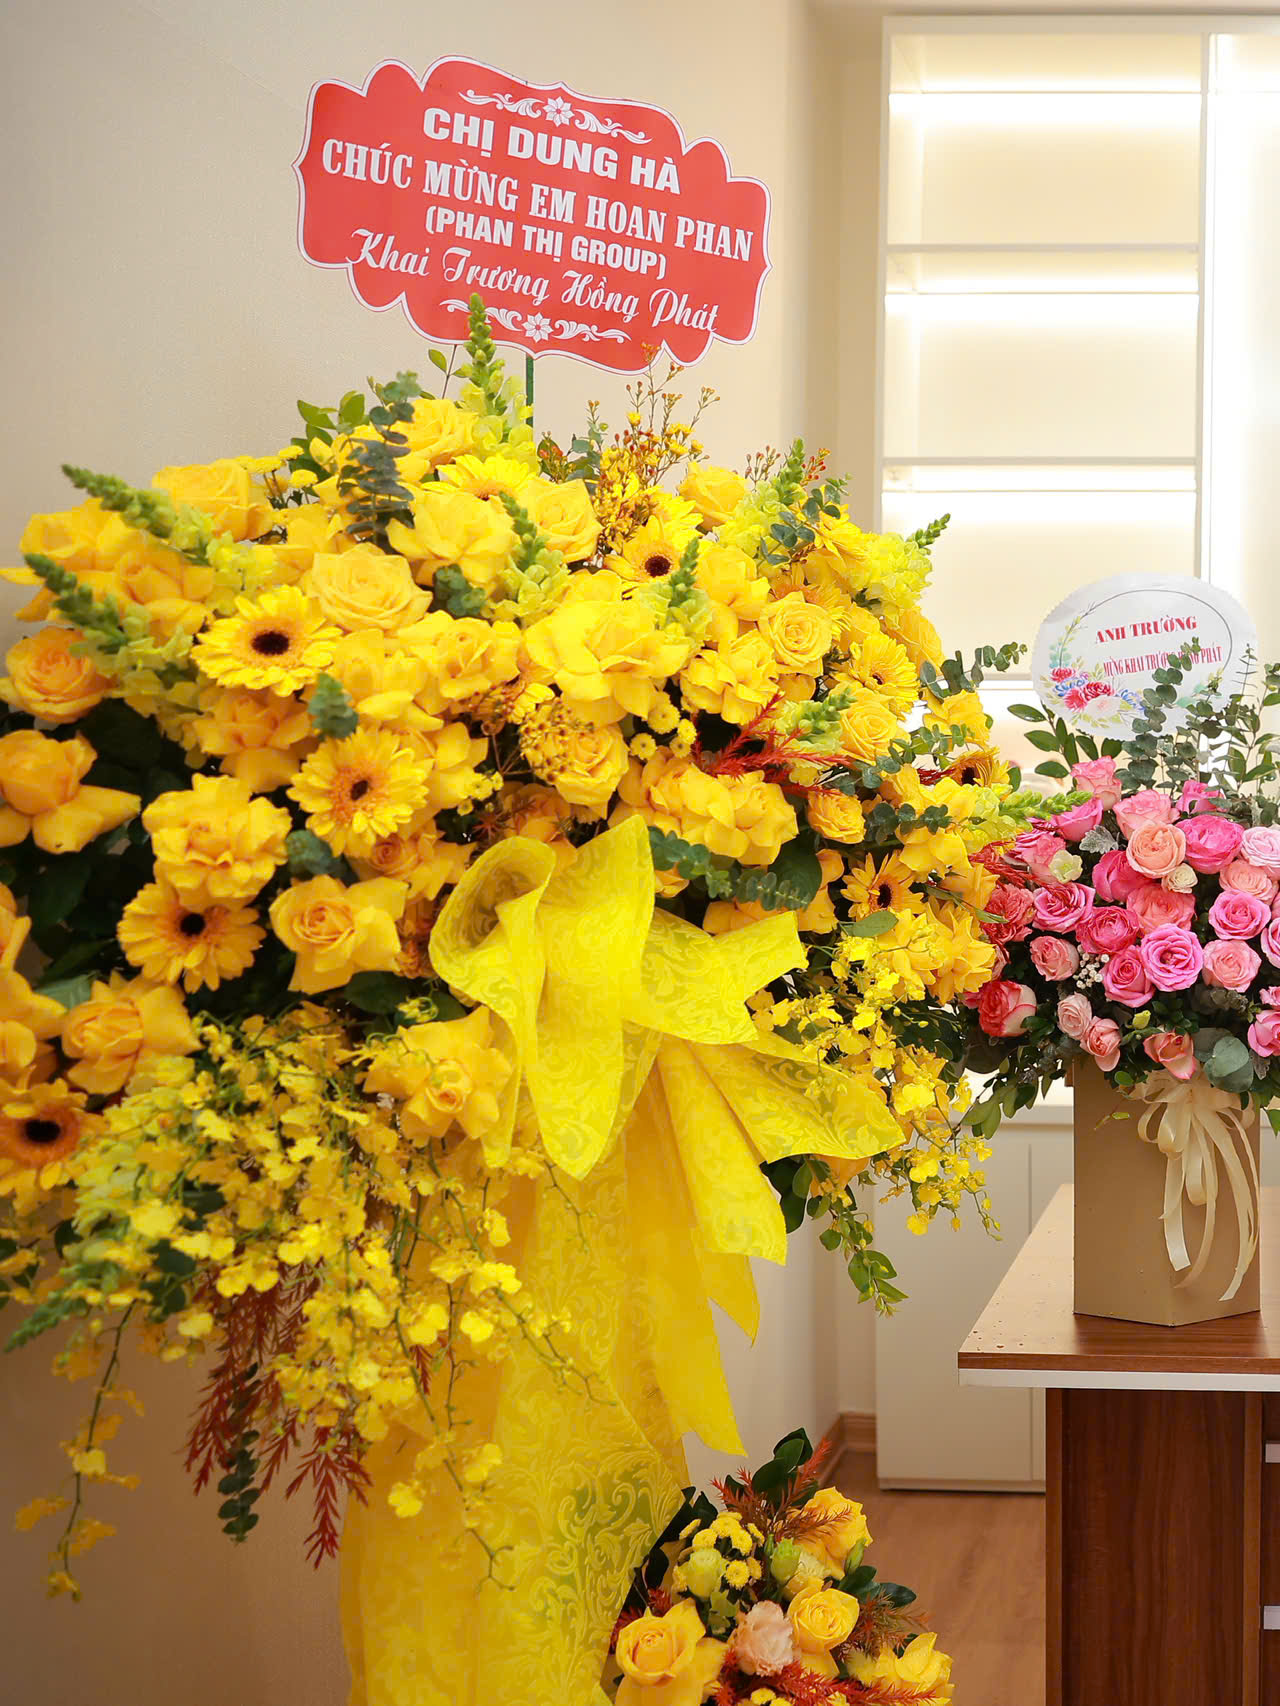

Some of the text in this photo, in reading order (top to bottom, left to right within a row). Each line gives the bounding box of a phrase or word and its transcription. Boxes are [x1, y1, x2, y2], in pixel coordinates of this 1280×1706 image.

[423, 107, 681, 195] CHỊ DUNG HÀ
[322, 138, 754, 262] CHÚC MỪNG EM HOAN PHAN
[346, 228, 719, 333] Khai Trương Hồng Phát
[425, 205, 667, 280] (PHAN THỊ GROUP)
[1096, 627, 1126, 644] ANH
[1125, 656, 1145, 674] KHAI
[1145, 651, 1176, 671] TRƯƠ
